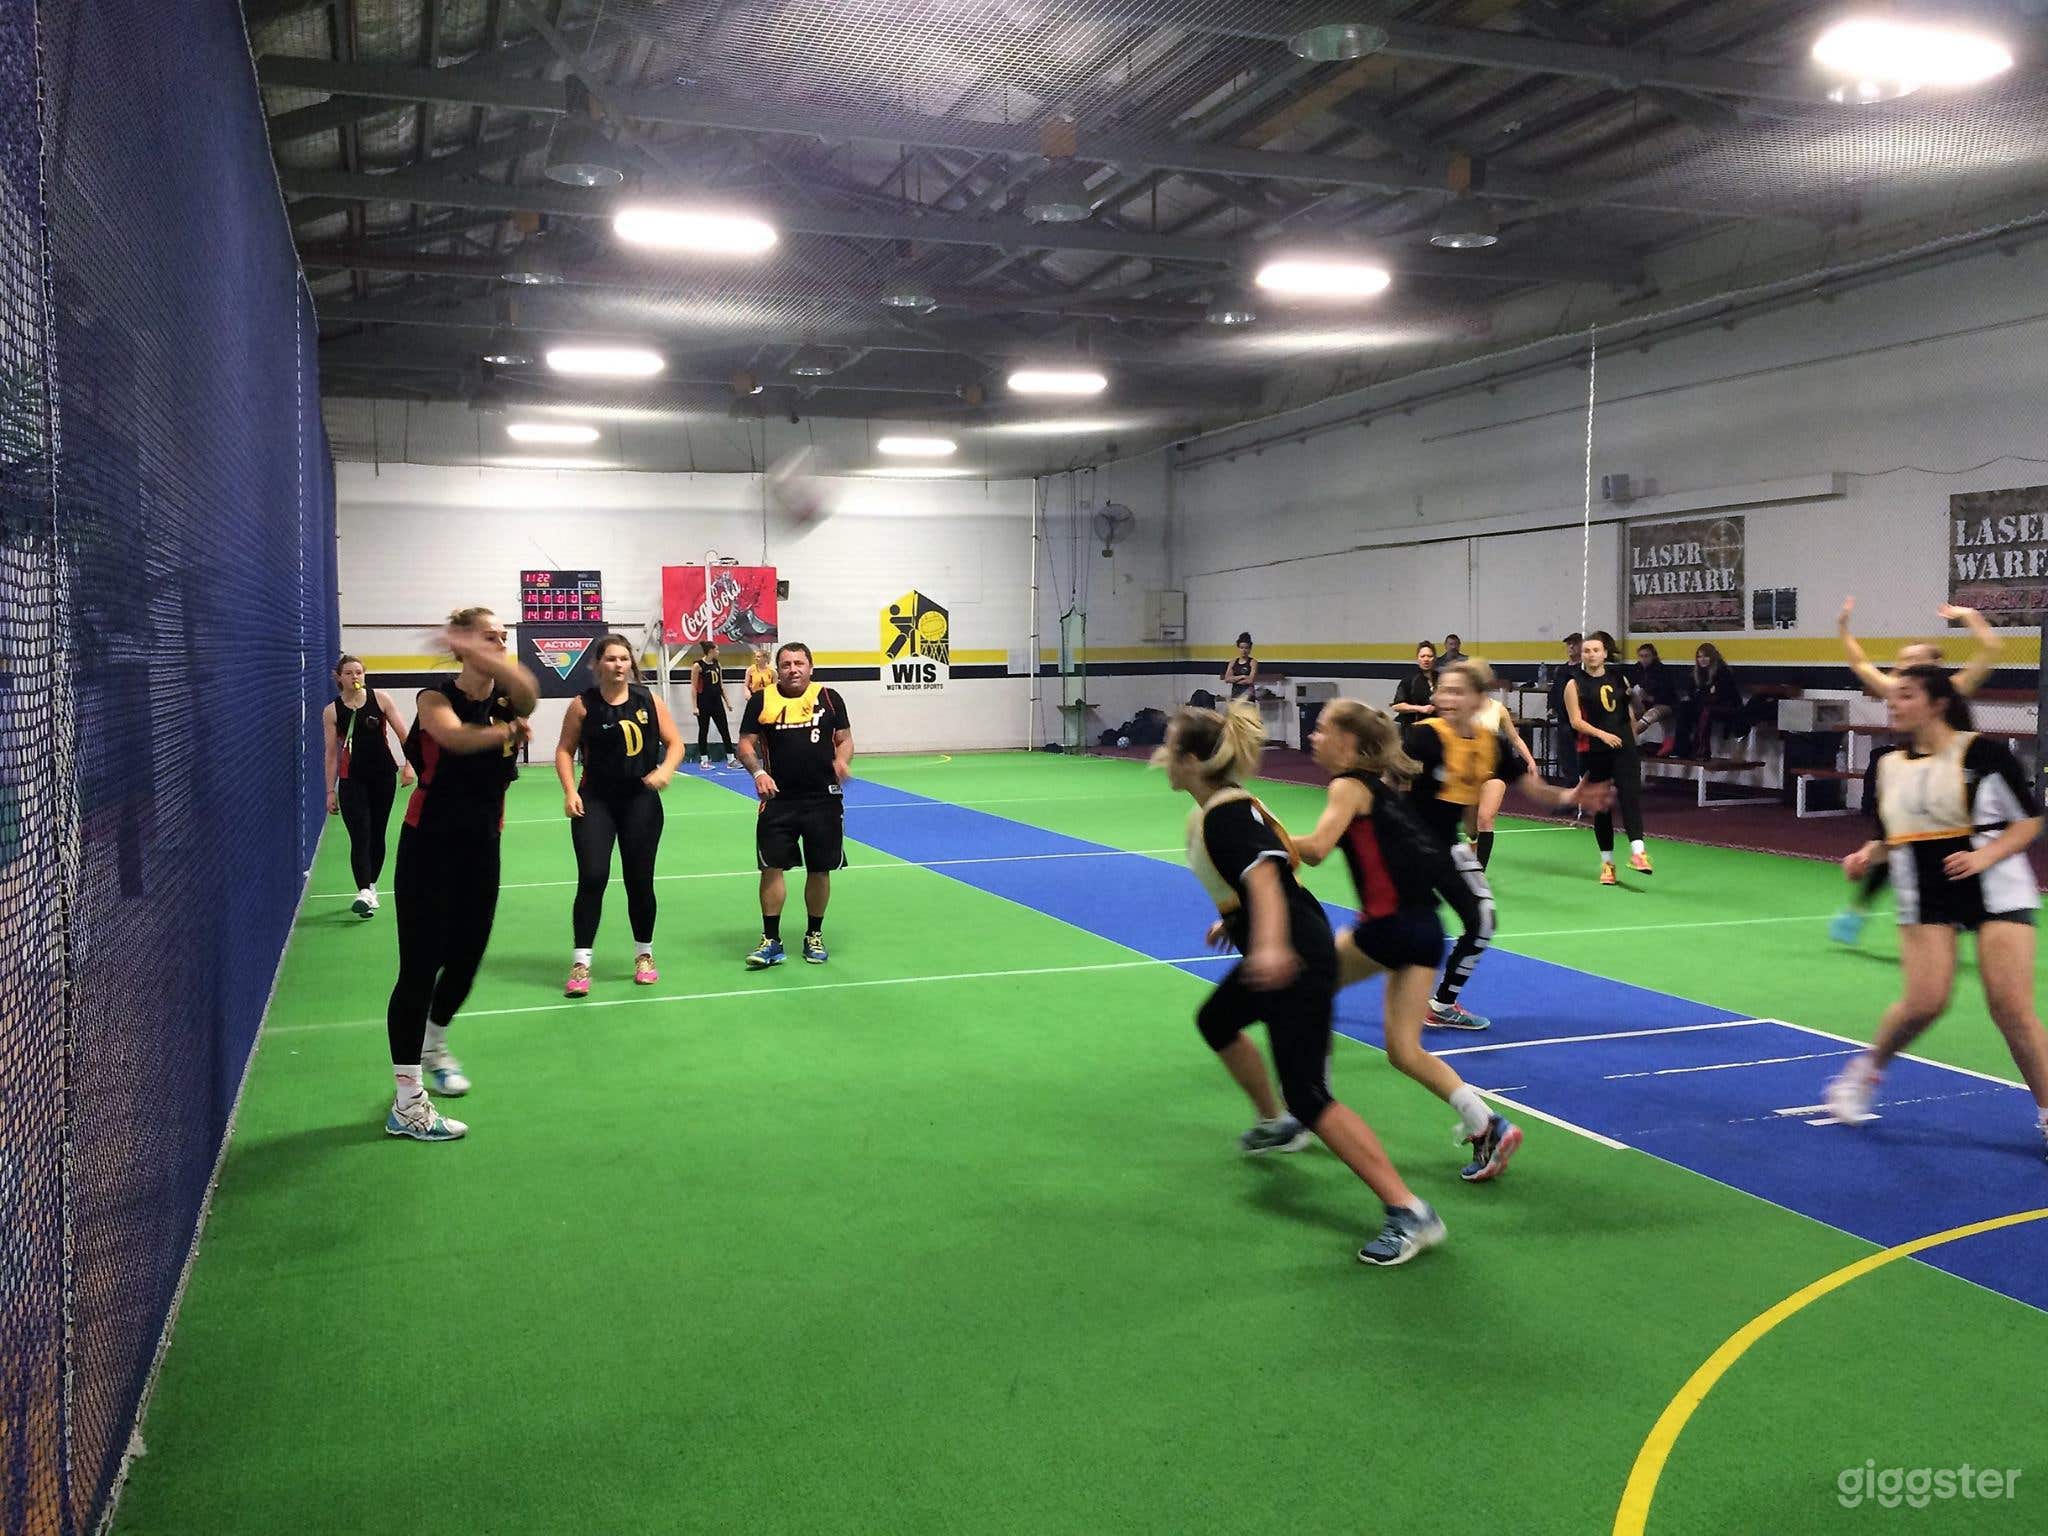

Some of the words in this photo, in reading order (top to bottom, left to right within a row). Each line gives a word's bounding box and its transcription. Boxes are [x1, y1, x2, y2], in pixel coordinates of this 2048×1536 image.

[1633, 542, 1702, 569] LASER
[1954, 549, 2048, 580] WARF
[1633, 568, 1737, 595] WARFARE
[681, 580, 741, 641] CocaCola
[544, 641, 582, 649] ACTION
[892, 663, 937, 683] WIS
[1600, 685, 1616, 712] C
[618, 720, 643, 756] D
[811, 729, 821, 743] 6
